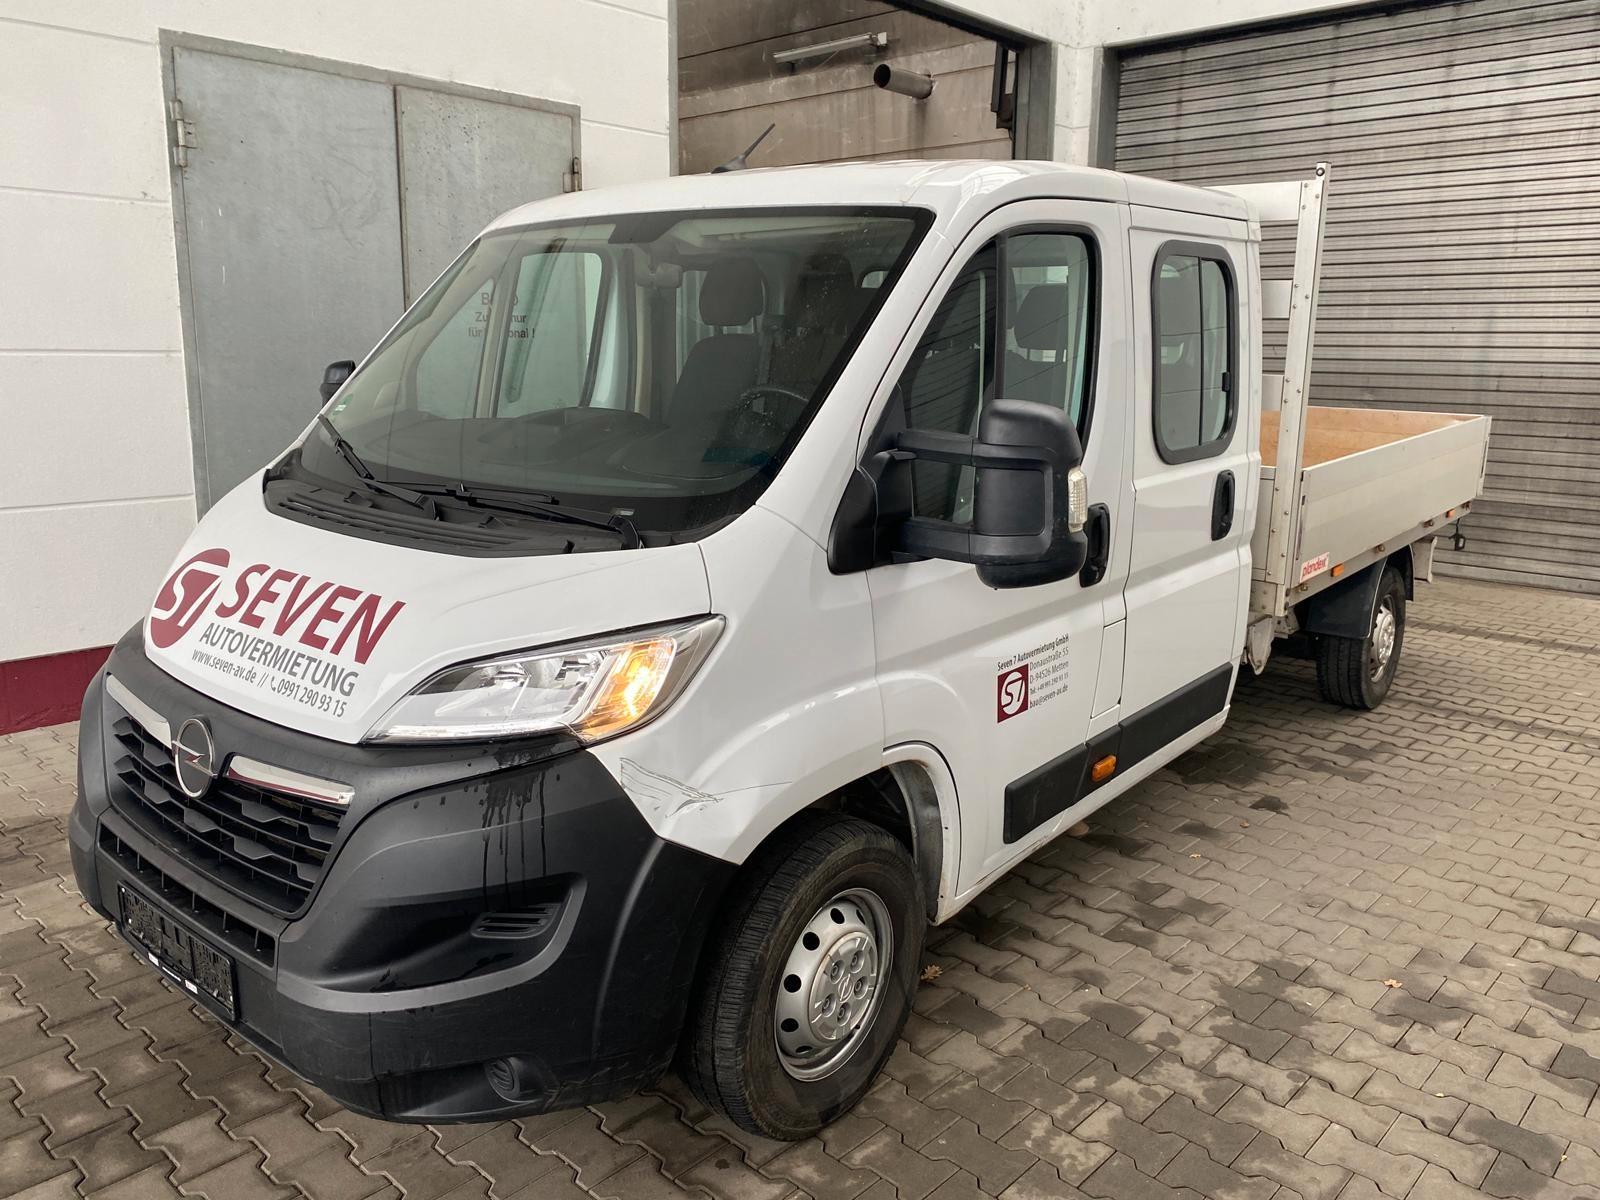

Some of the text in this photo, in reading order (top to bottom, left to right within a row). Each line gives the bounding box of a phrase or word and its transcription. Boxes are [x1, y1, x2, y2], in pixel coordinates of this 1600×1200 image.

[215, 563, 406, 665] SEVEN
[200, 622, 359, 696] AUTOVERMIETUNG
[997, 633, 1069, 671] Seven 7 Autovermietung GmbH
[1029, 646, 1069, 671] Donaustraße 55
[1051, 661, 1069, 673] Metten
[191, 649, 257, 684] www.seven-av.de
[277, 678, 300, 700] 0991
[299, 687, 318, 707] 290
[318, 693, 333, 712] 93
[332, 699, 347, 718] 15
